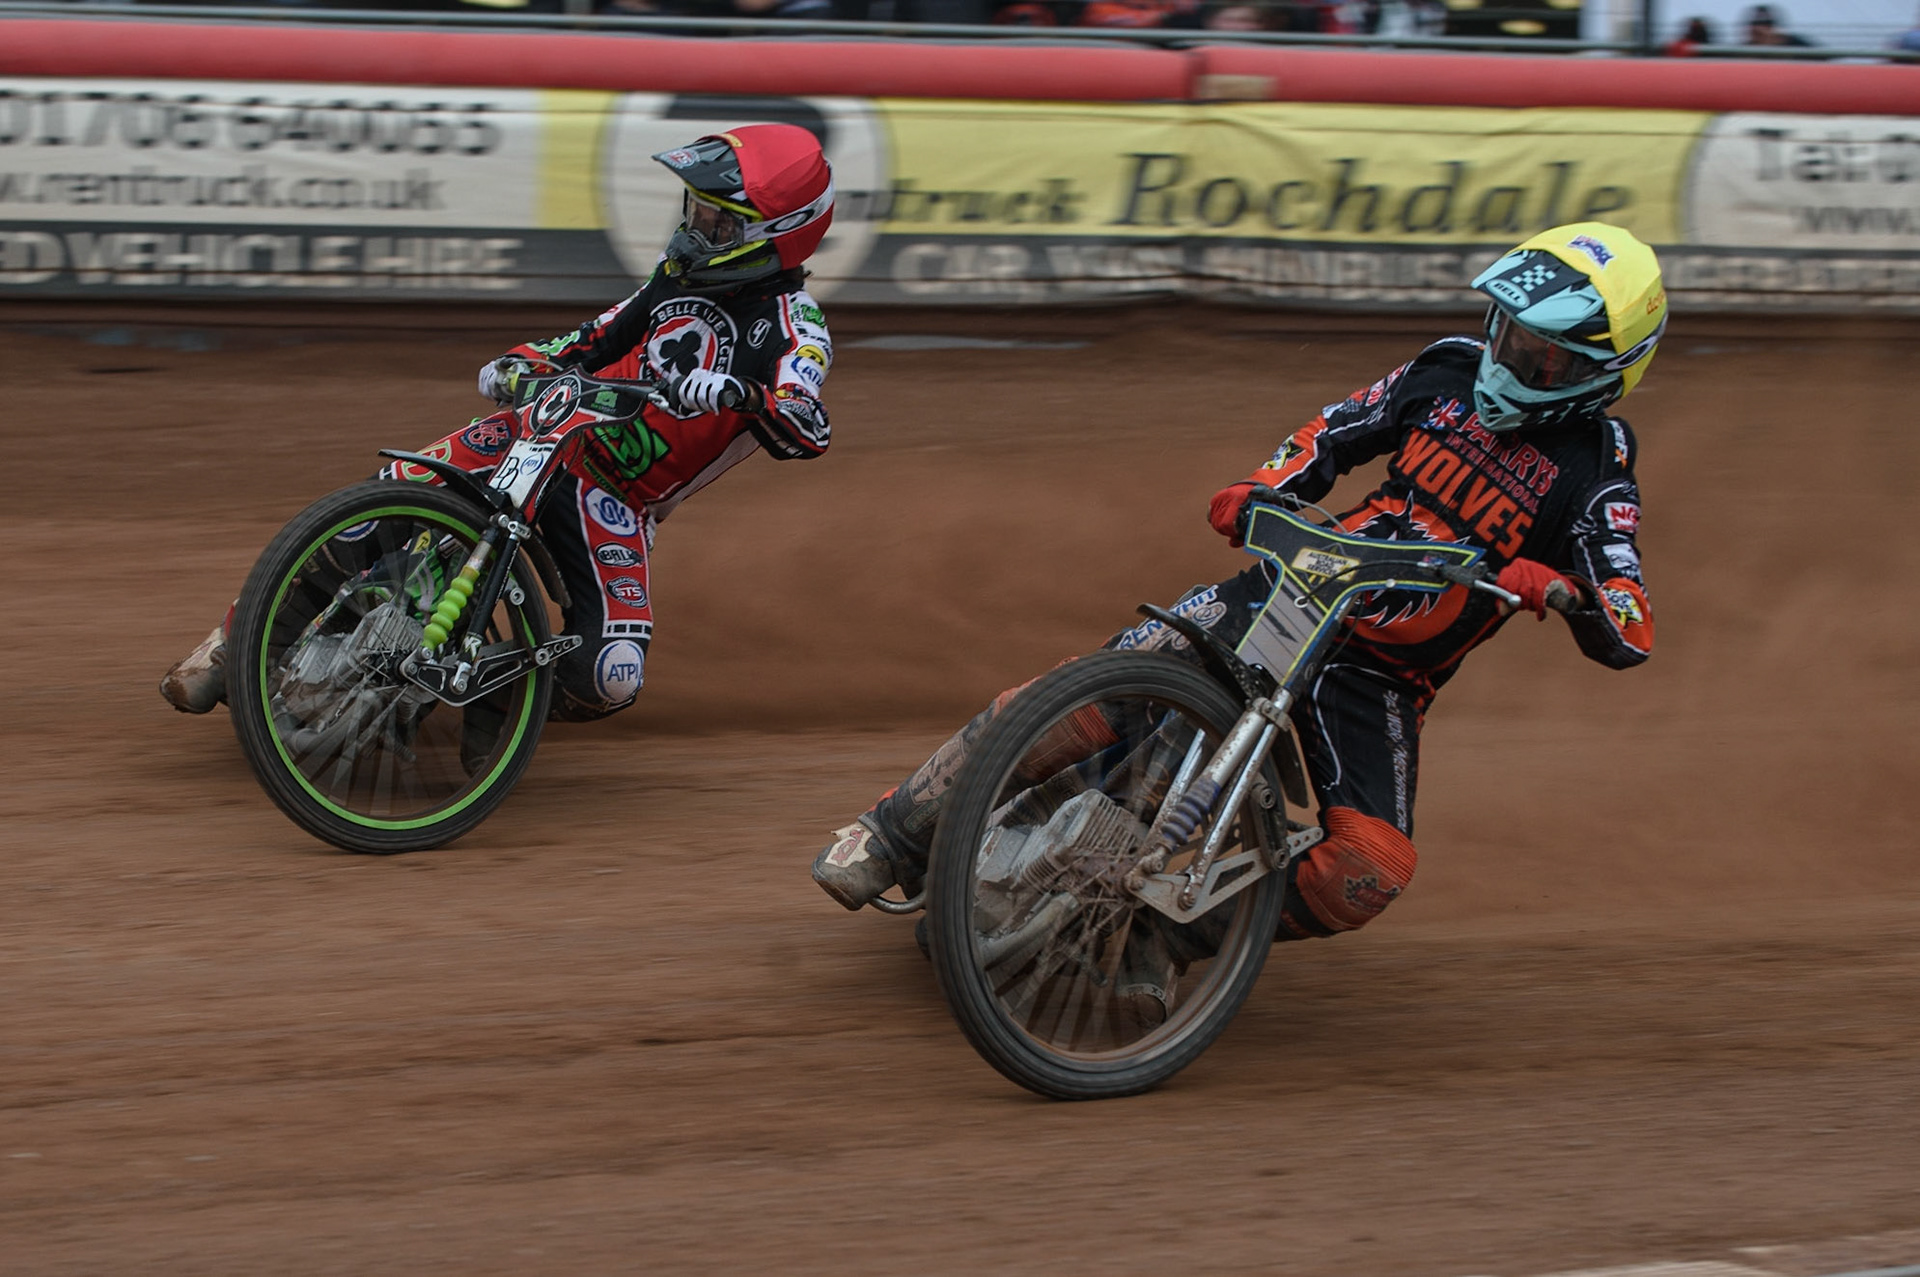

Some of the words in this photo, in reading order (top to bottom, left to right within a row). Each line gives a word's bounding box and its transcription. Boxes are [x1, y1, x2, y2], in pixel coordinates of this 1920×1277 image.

[1104, 152, 1634, 234] Rochdale
[67, 232, 358, 288] VEHICLE
[362, 236, 525, 290] HIRE
[657, 302, 701, 323] BELLE
[1493, 282, 1522, 304] BELL
[1395, 427, 1534, 560] WOLVES
[606, 663, 638, 682] ATPI
